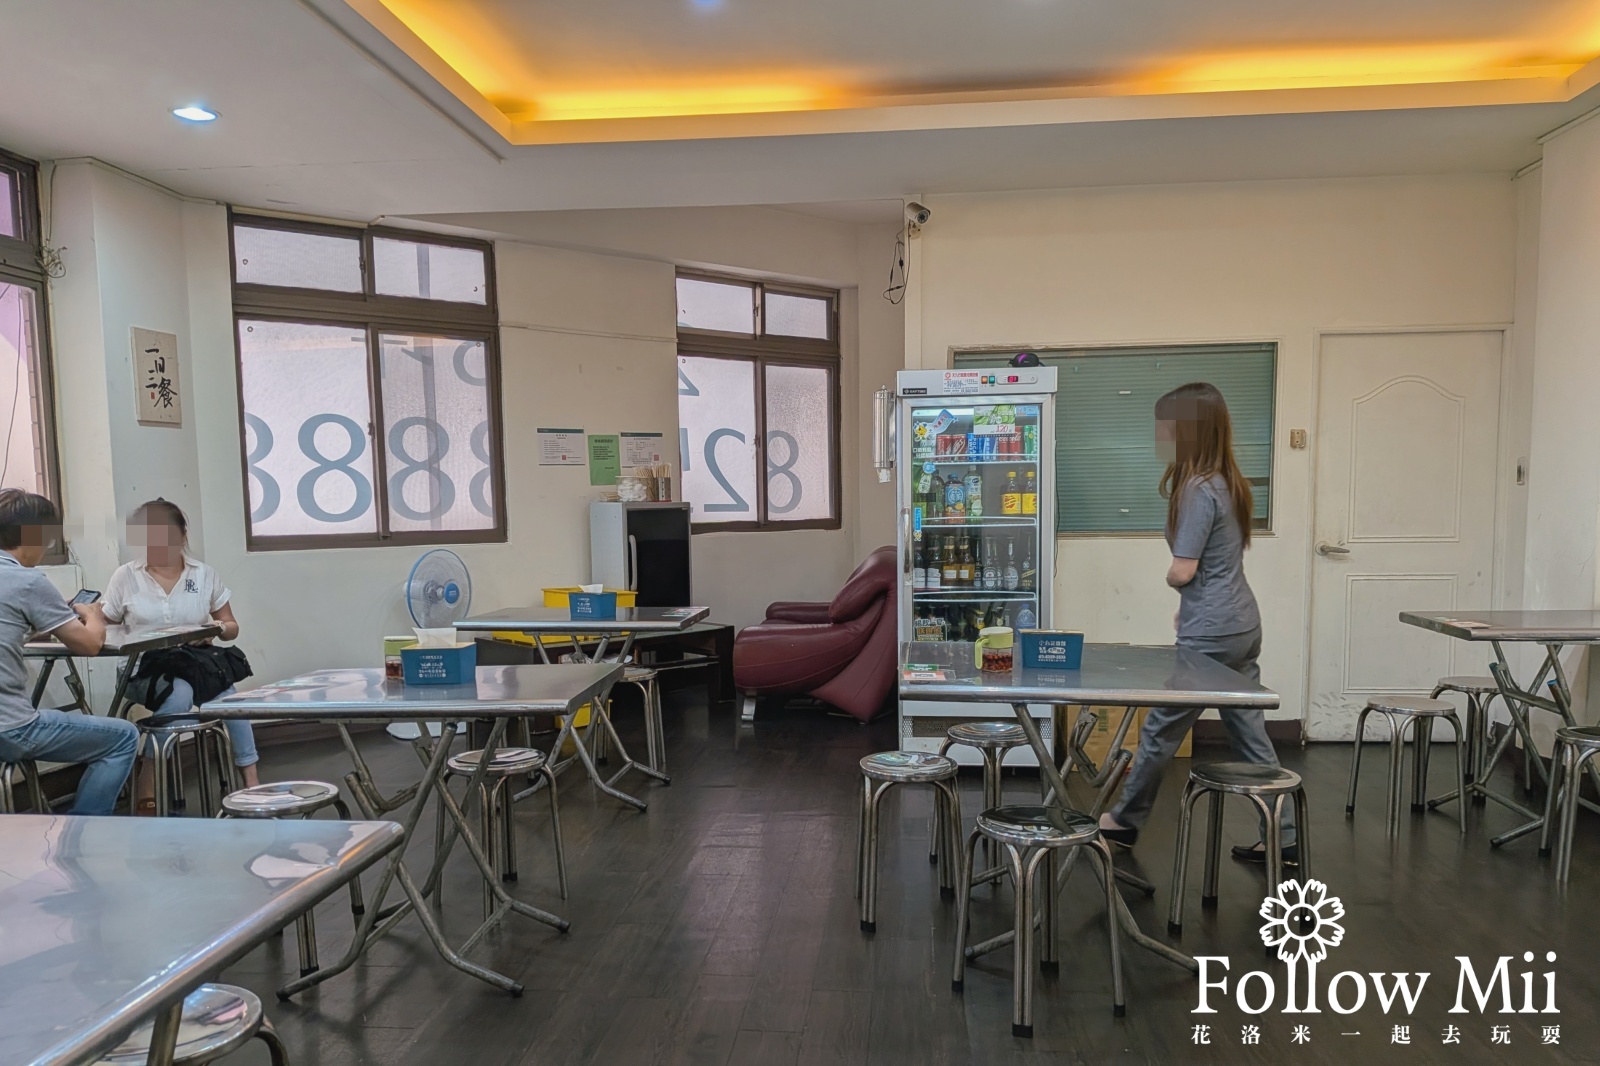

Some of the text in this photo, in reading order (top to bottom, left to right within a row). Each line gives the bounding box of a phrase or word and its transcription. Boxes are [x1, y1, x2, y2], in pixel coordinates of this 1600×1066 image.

[144, 347, 178, 409] 一日三餐
[995, 425, 1009, 433] 120
